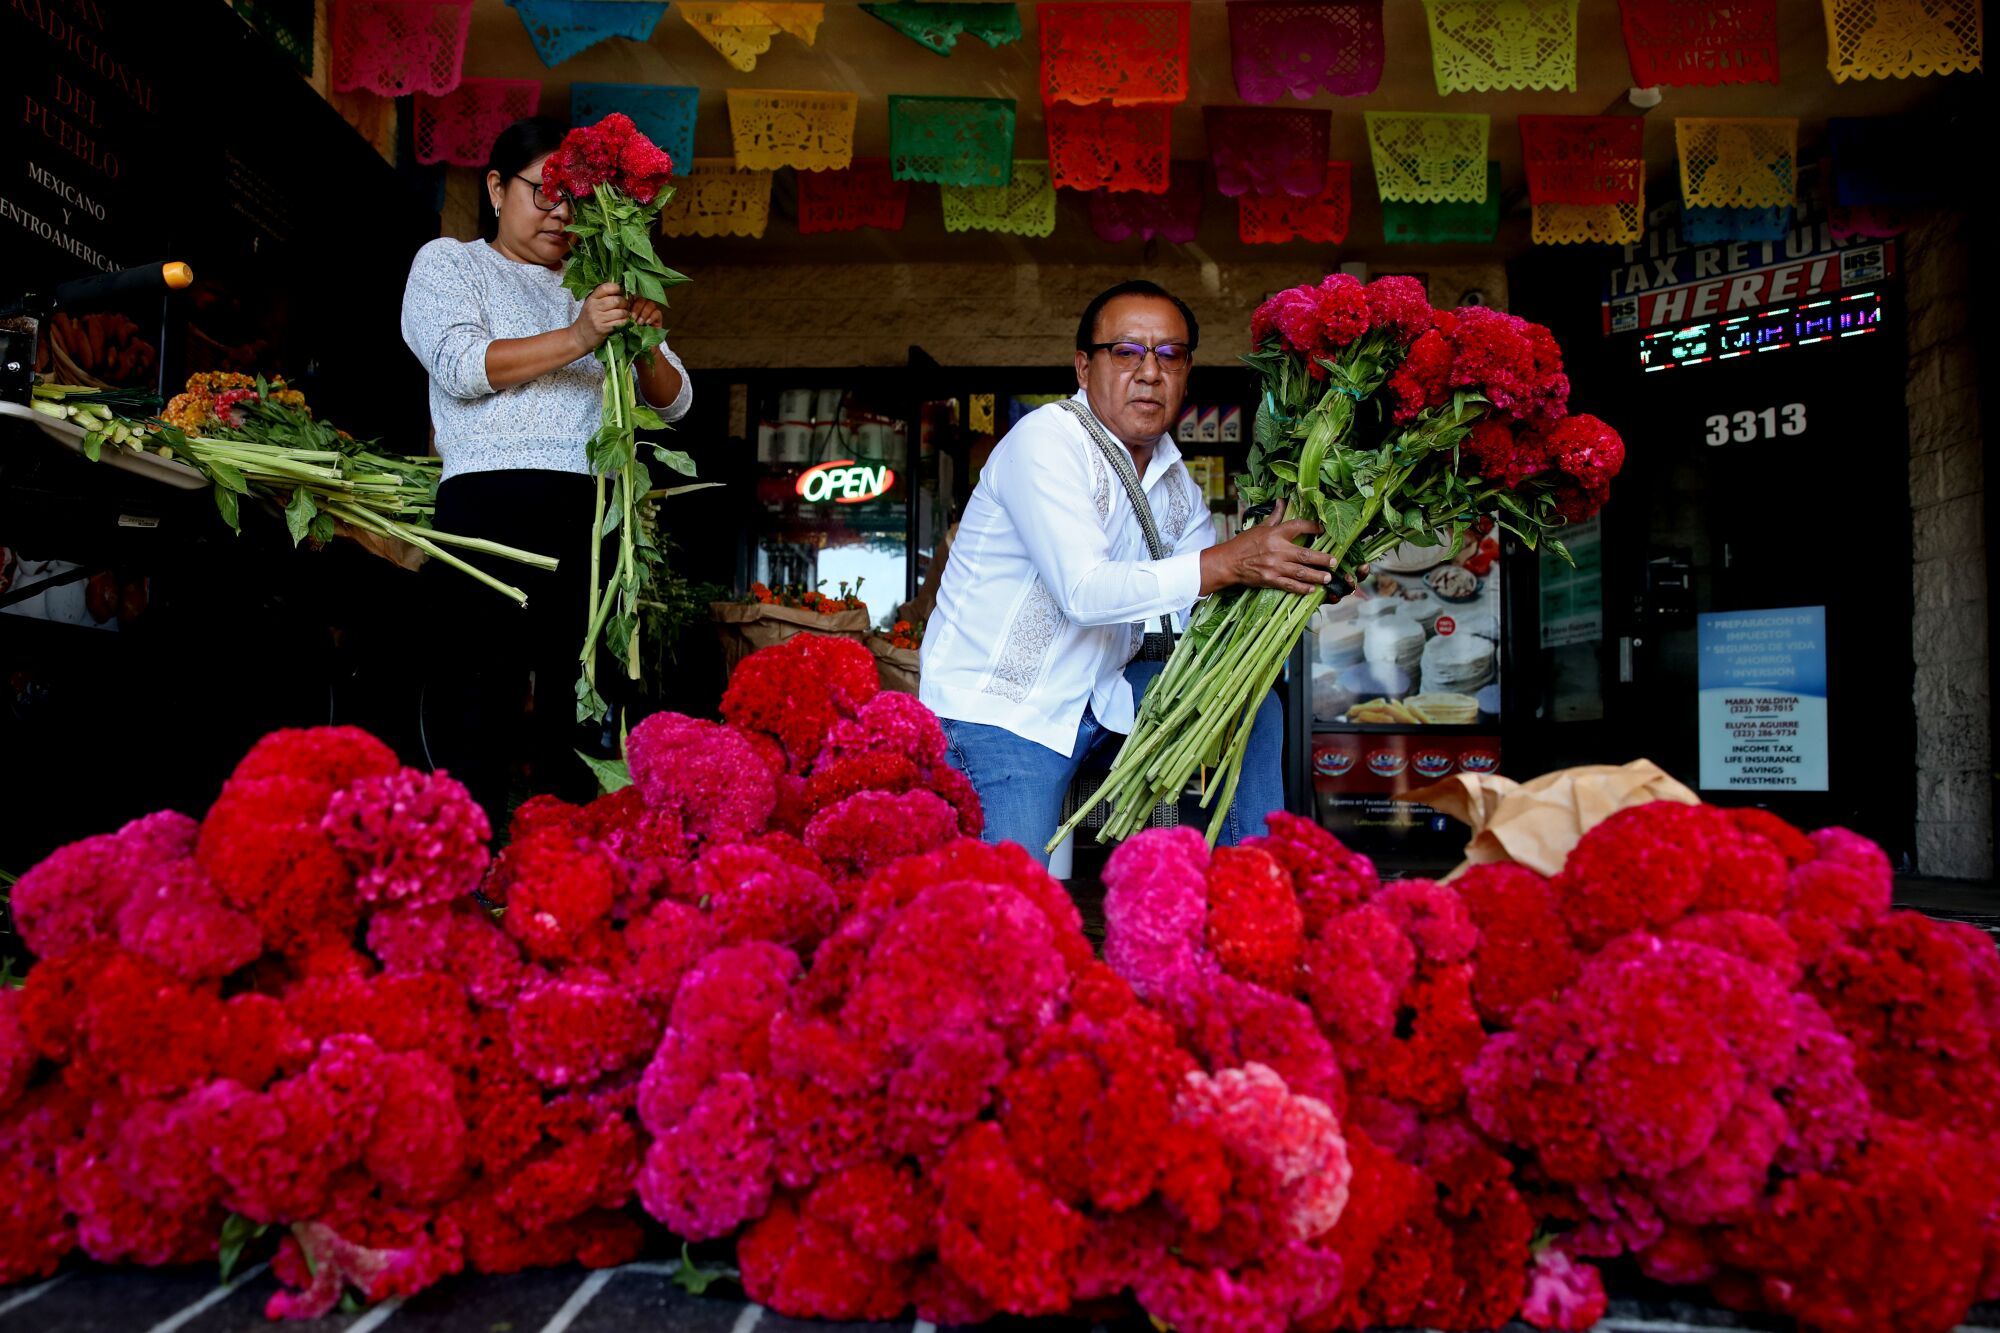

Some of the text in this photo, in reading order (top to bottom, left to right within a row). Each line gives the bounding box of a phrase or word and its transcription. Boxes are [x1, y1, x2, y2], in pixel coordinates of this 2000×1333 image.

[55, 73, 105, 130] DEL
[22, 94, 119, 180] PUEBLO
[28, 160, 106, 222] MEXICANO
[62, 207, 73, 226] Y
[1844, 250, 1881, 271] IRS
[1609, 254, 1680, 298] TAX
[1650, 258, 1829, 328] HERE!
[1704, 402, 1808, 447] 3313
[803, 465, 887, 502] OPEN
[1714, 614, 1814, 629] PREPARACION DE
[1726, 629, 1792, 640] IMPUESTOS
[1712, 640, 1816, 654] SEGUROS DE VIDA
[1735, 655, 1792, 665] AHORROS
[1732, 745, 1770, 753] INCOME
[1742, 766, 1784, 774] SAVINGS
[1729, 777, 1797, 785] INVESTMENTS
